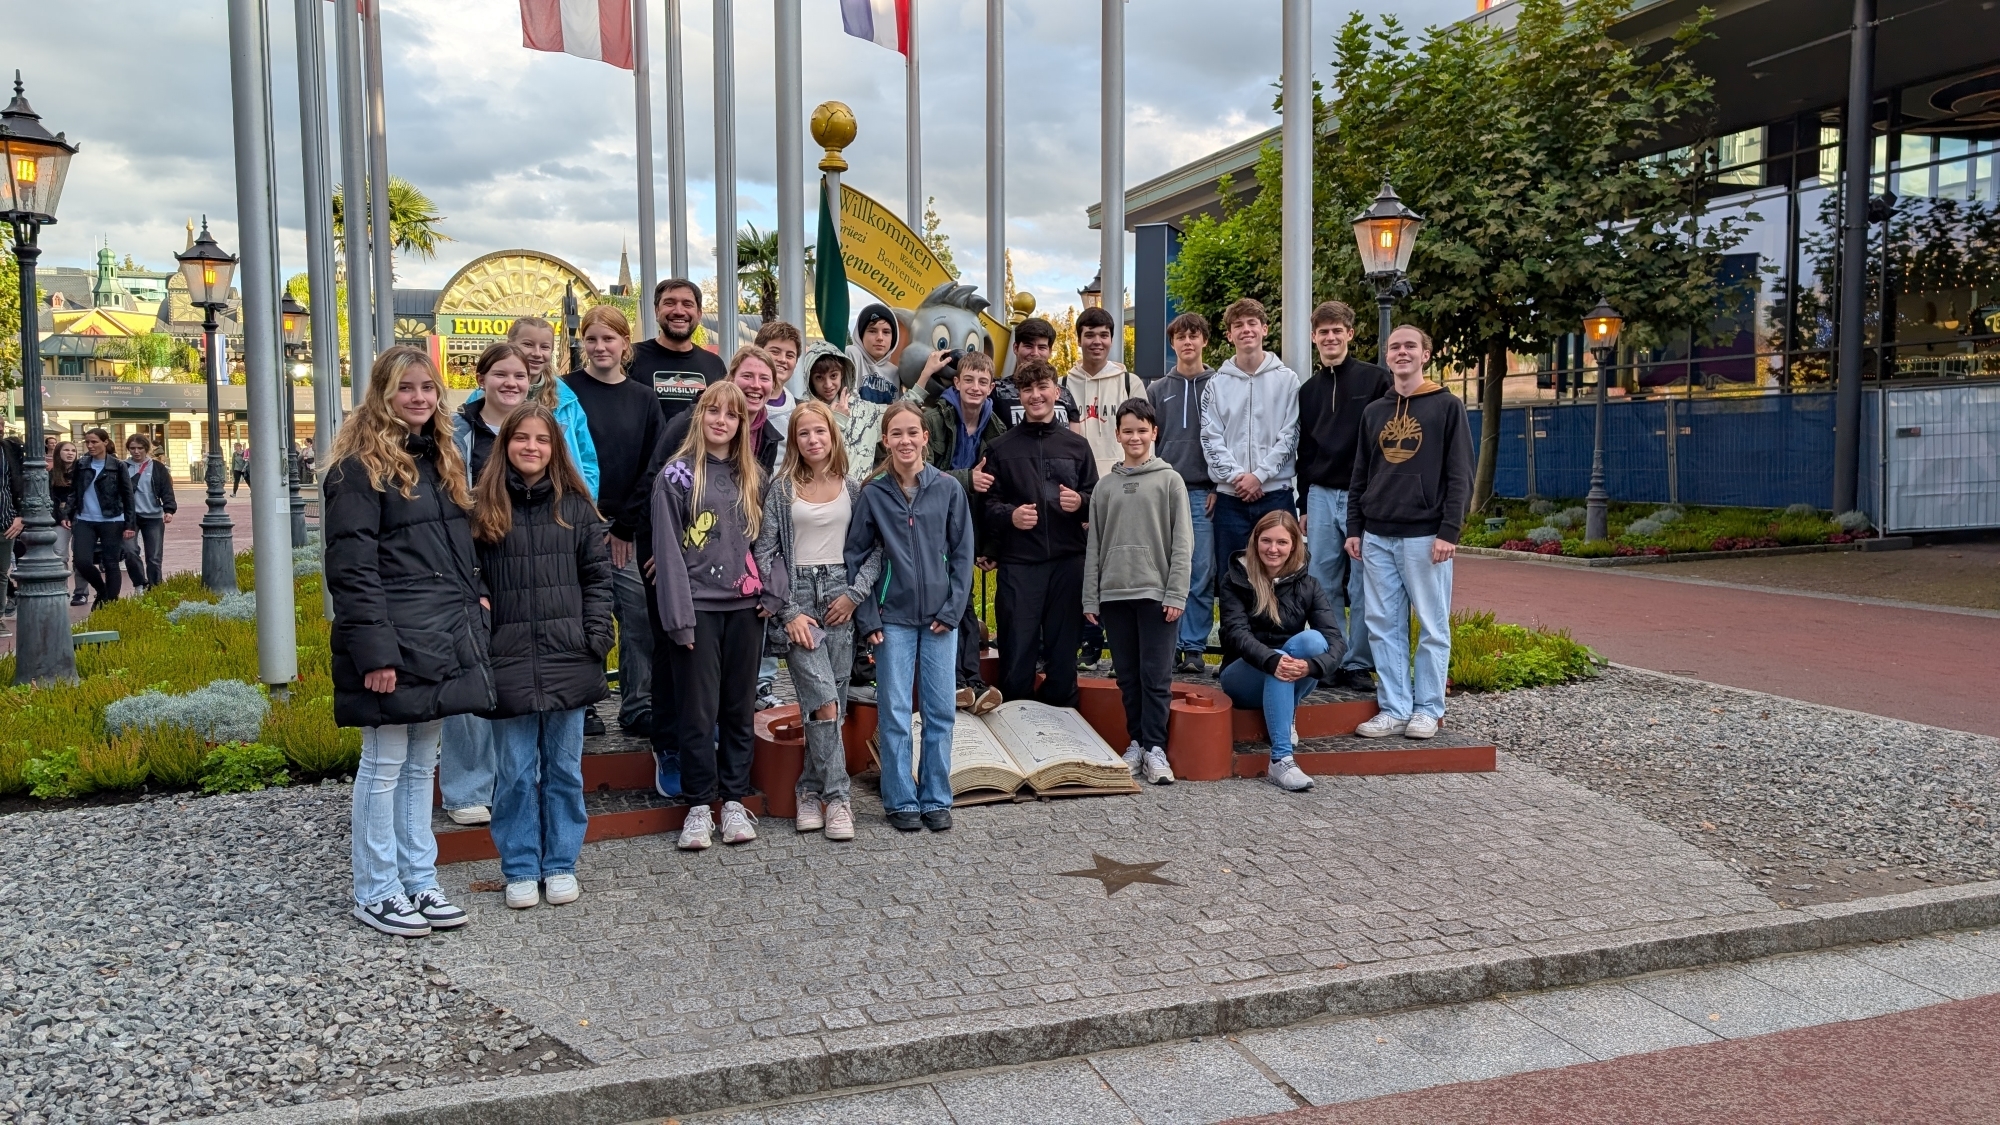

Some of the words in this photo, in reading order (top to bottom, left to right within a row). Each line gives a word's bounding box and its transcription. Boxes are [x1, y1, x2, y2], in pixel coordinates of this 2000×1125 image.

[839, 187, 933, 273] Willkommen
[840, 241, 906, 302] ienvenue
[877, 247, 926, 296] Benvenuto
[899, 253, 923, 278] Welkom
[1078, 404, 1117, 417] ORDAN
